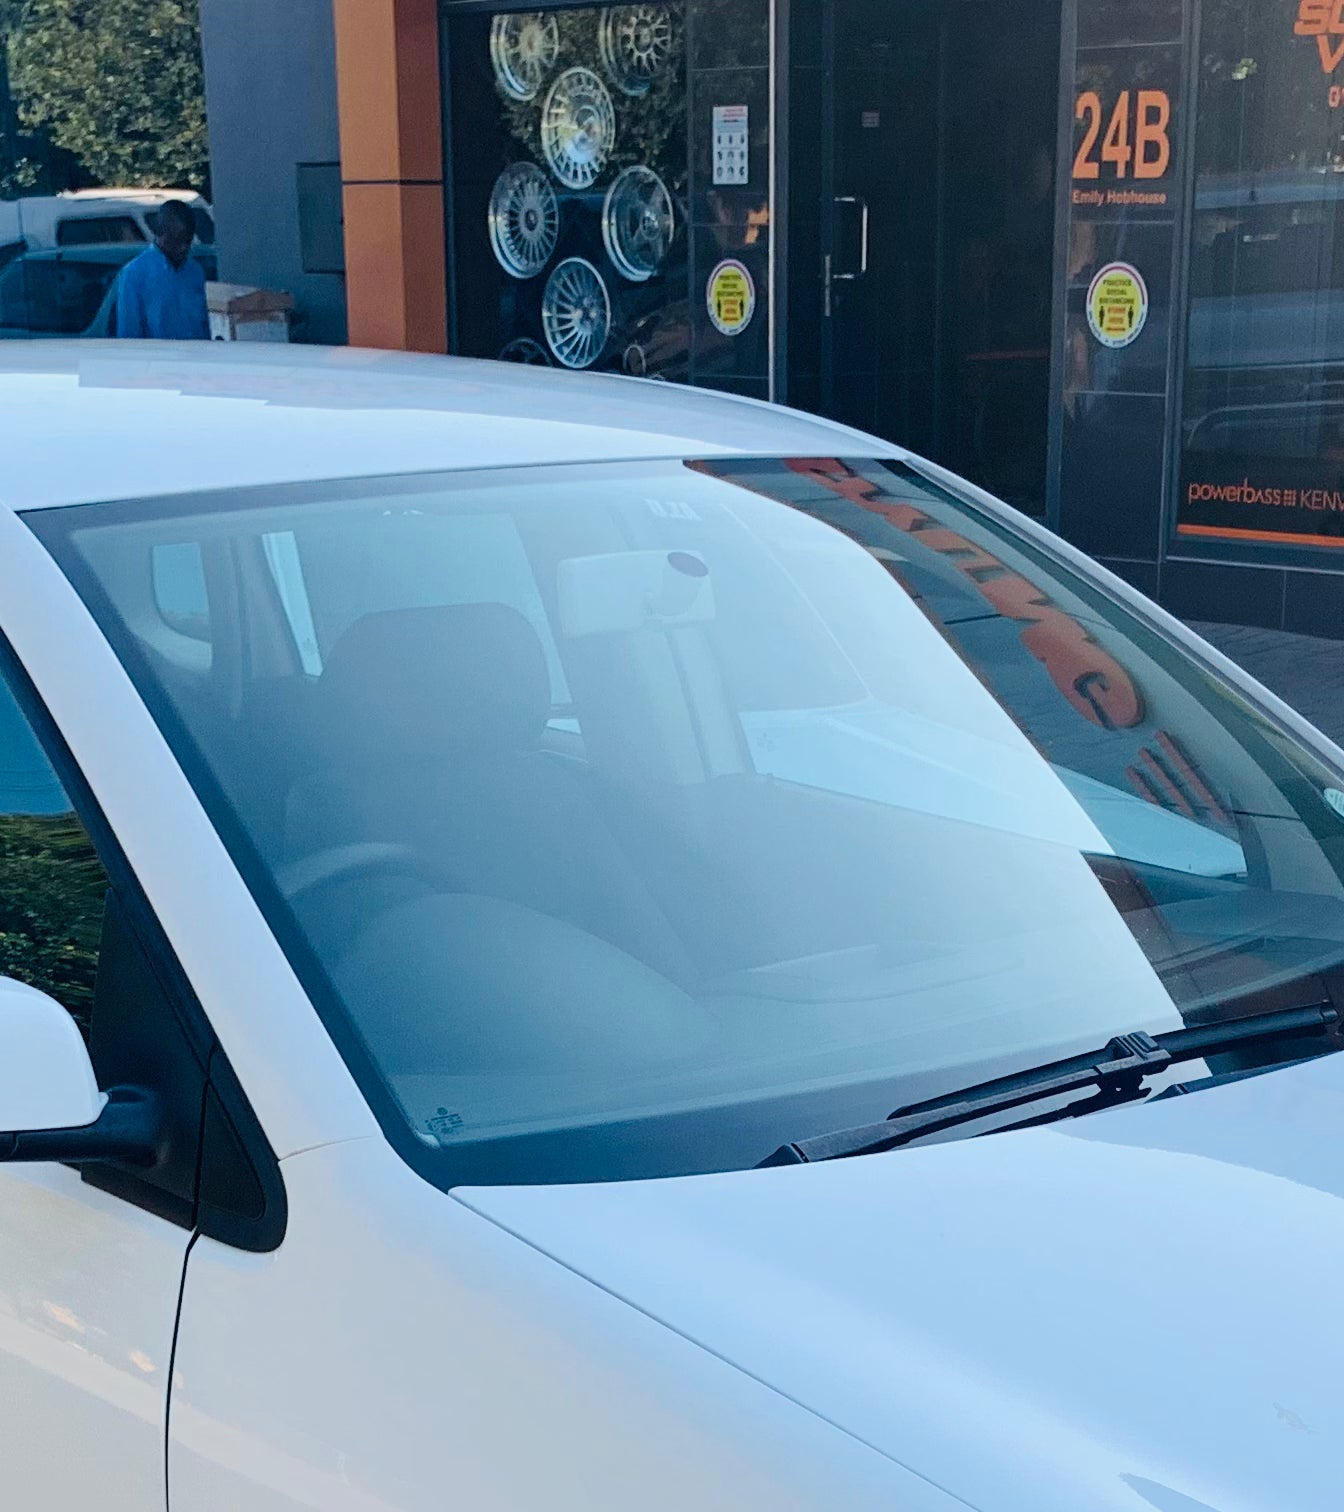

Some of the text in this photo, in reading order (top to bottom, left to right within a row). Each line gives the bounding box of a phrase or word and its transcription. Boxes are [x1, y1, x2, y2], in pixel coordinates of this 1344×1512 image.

[1072, 90, 1170, 179] 24B
[1072, 190, 1167, 207] Emily Hobhouse
